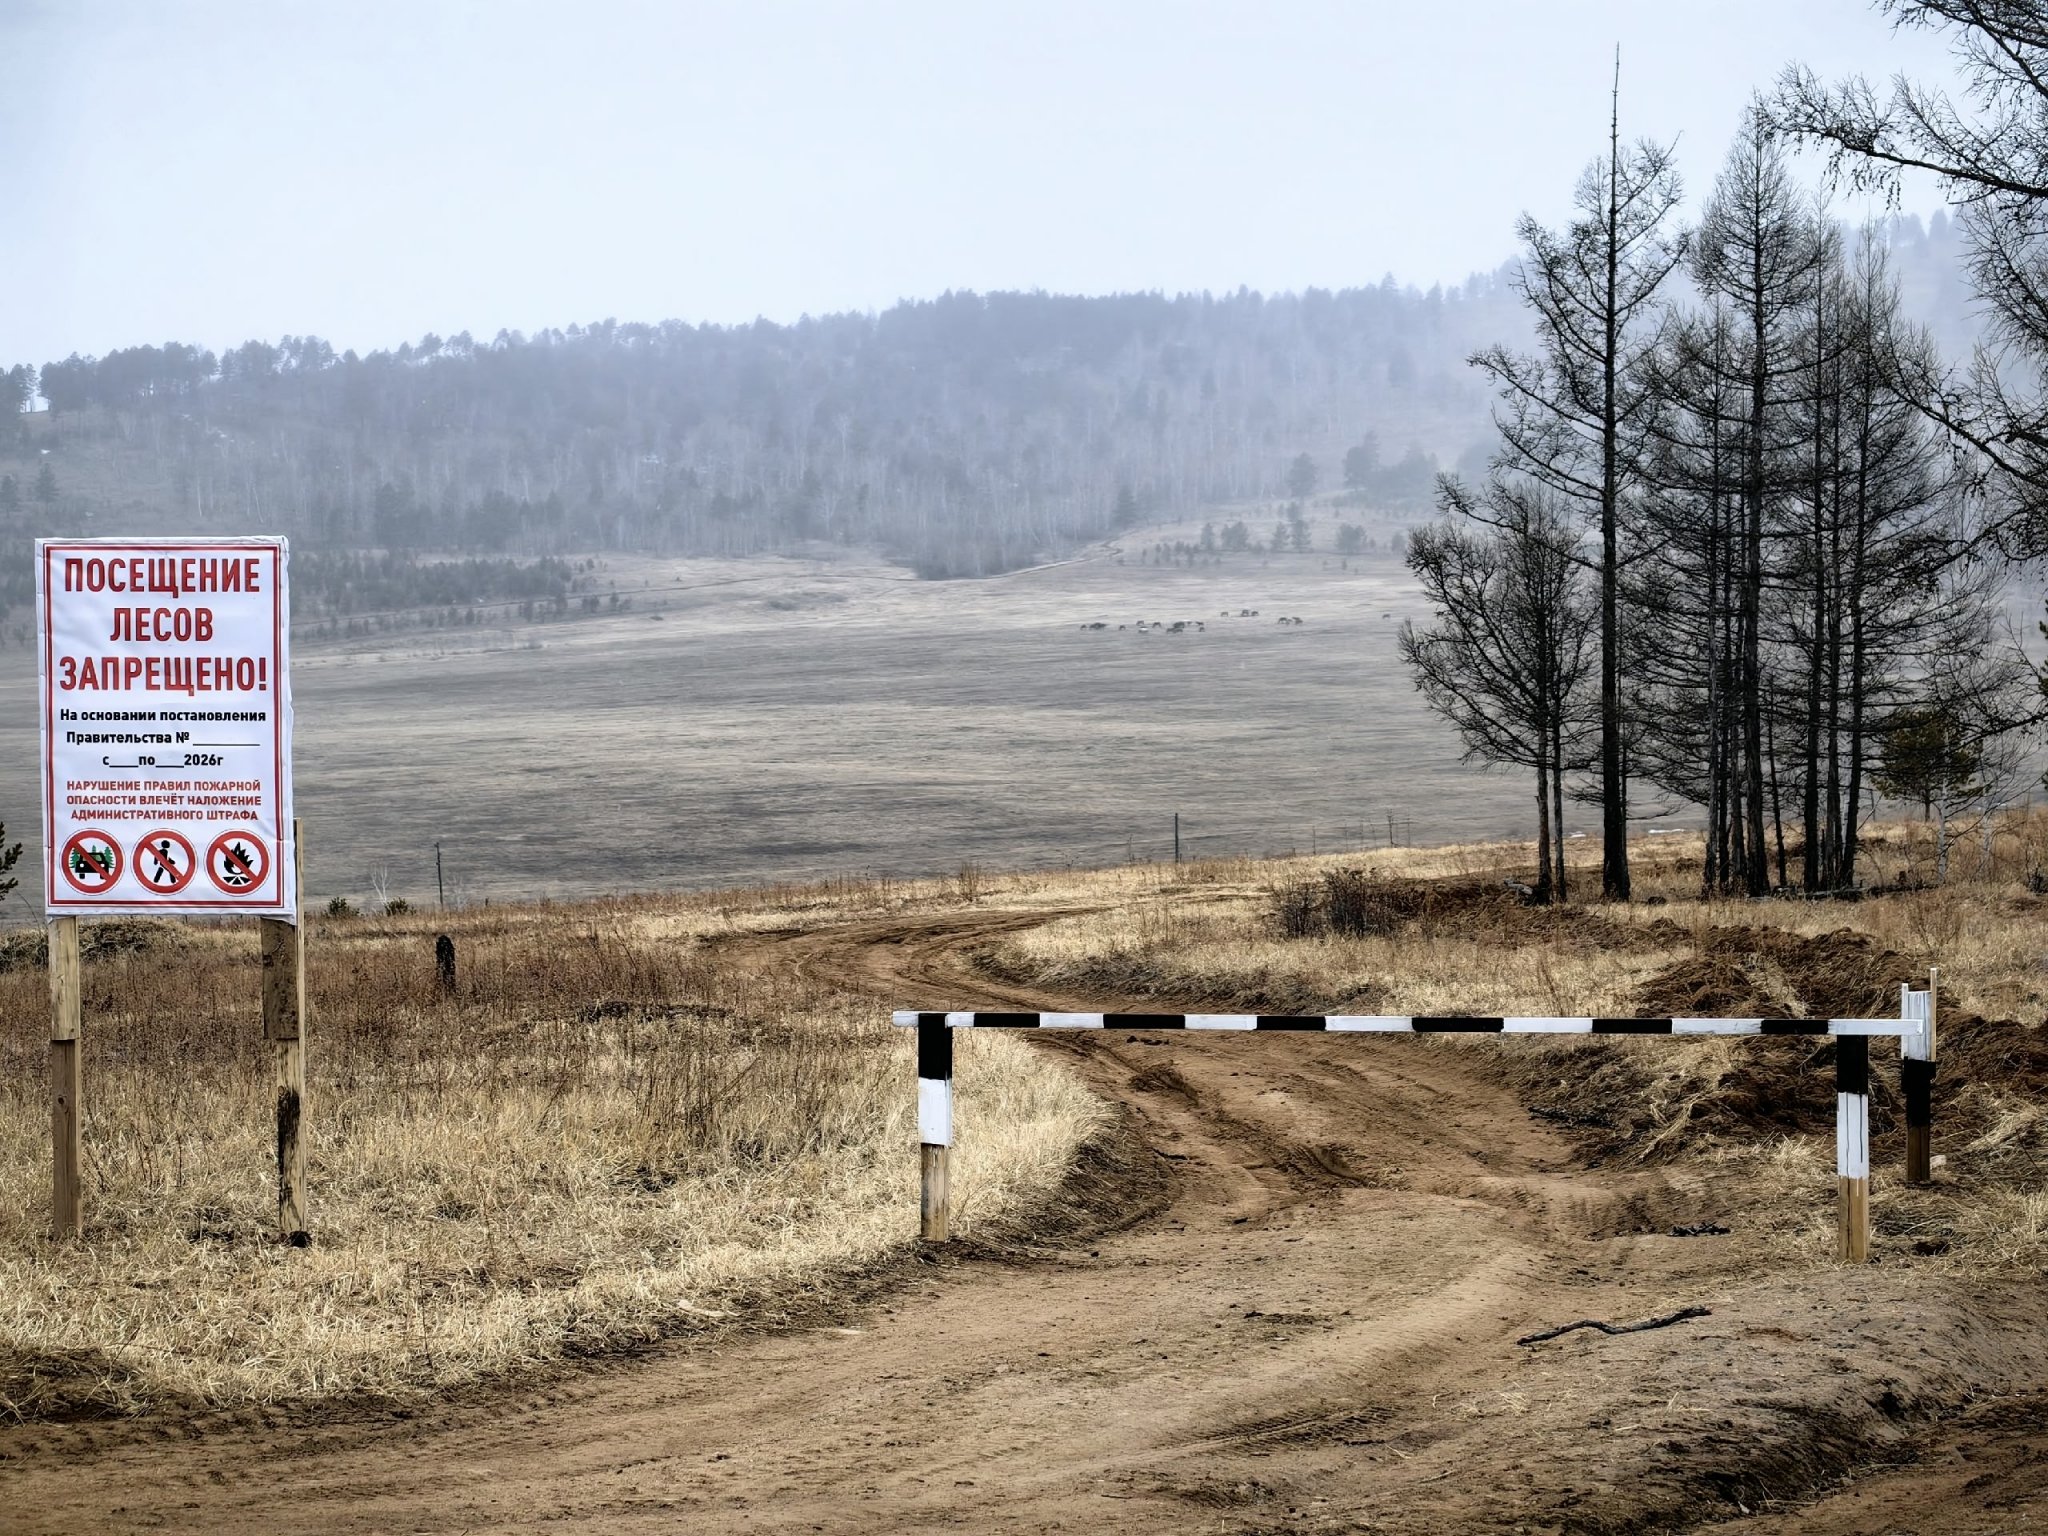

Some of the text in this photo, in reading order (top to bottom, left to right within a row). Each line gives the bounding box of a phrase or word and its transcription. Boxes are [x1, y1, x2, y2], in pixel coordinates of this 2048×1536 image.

[64, 557, 260, 598] ПОСЕЩЕНИЕ
[110, 607, 213, 641] ЛЕСОВ
[59, 656, 267, 696] ЗАПРЕЩЕНО!
[60, 709, 266, 722] На основании постановления
[66, 731, 190, 745] Правительства №
[66, 779, 261, 791] НАРУШЕНИЕ ПРАВИЛ ПОЖАРНОЙ
[66, 793, 262, 806] ОПАСНОСТИ ВЛЕЧЁТ НАЛОЖЕНИЕ
[71, 810, 258, 821] АДМИНИСТРАТИВНОГО ШТРАФА
